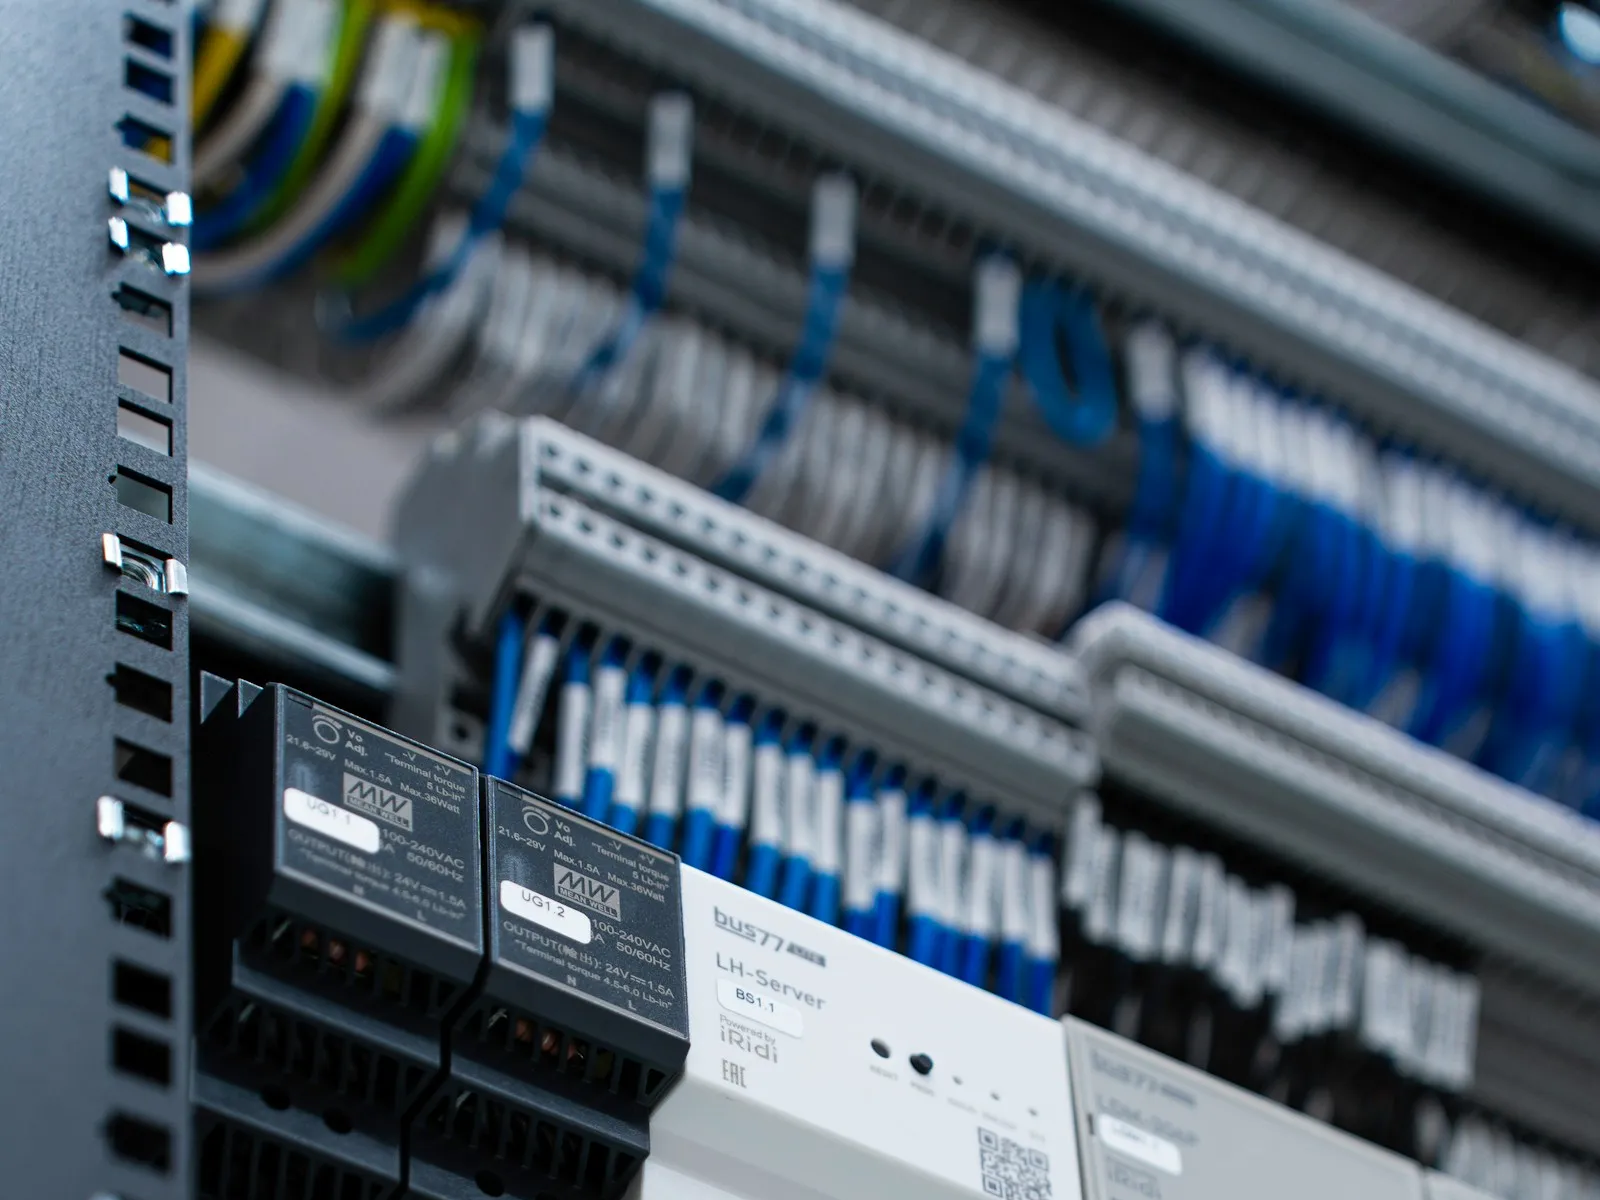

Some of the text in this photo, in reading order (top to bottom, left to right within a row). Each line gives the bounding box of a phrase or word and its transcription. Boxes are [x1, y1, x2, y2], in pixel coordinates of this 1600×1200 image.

[347, 729, 363, 742] Vo
[434, 774, 465, 793] torque
[555, 820, 570, 833] Vo
[406, 851, 464, 882] 50/60Hz
[639, 863, 670, 882] torque
[558, 871, 616, 902] MW
[560, 886, 618, 916] MEAN WELL
[521, 889, 566, 918] UG1.2
[592, 919, 672, 958] 100-240VAC
[713, 905, 785, 953] bus77
[616, 942, 672, 971] 50/60Hz
[716, 951, 826, 1011] LH-Server
[735, 987, 775, 1013] BS1.1
[720, 1013, 763, 1040] Powered
[720, 1025, 778, 1064] iRidi
